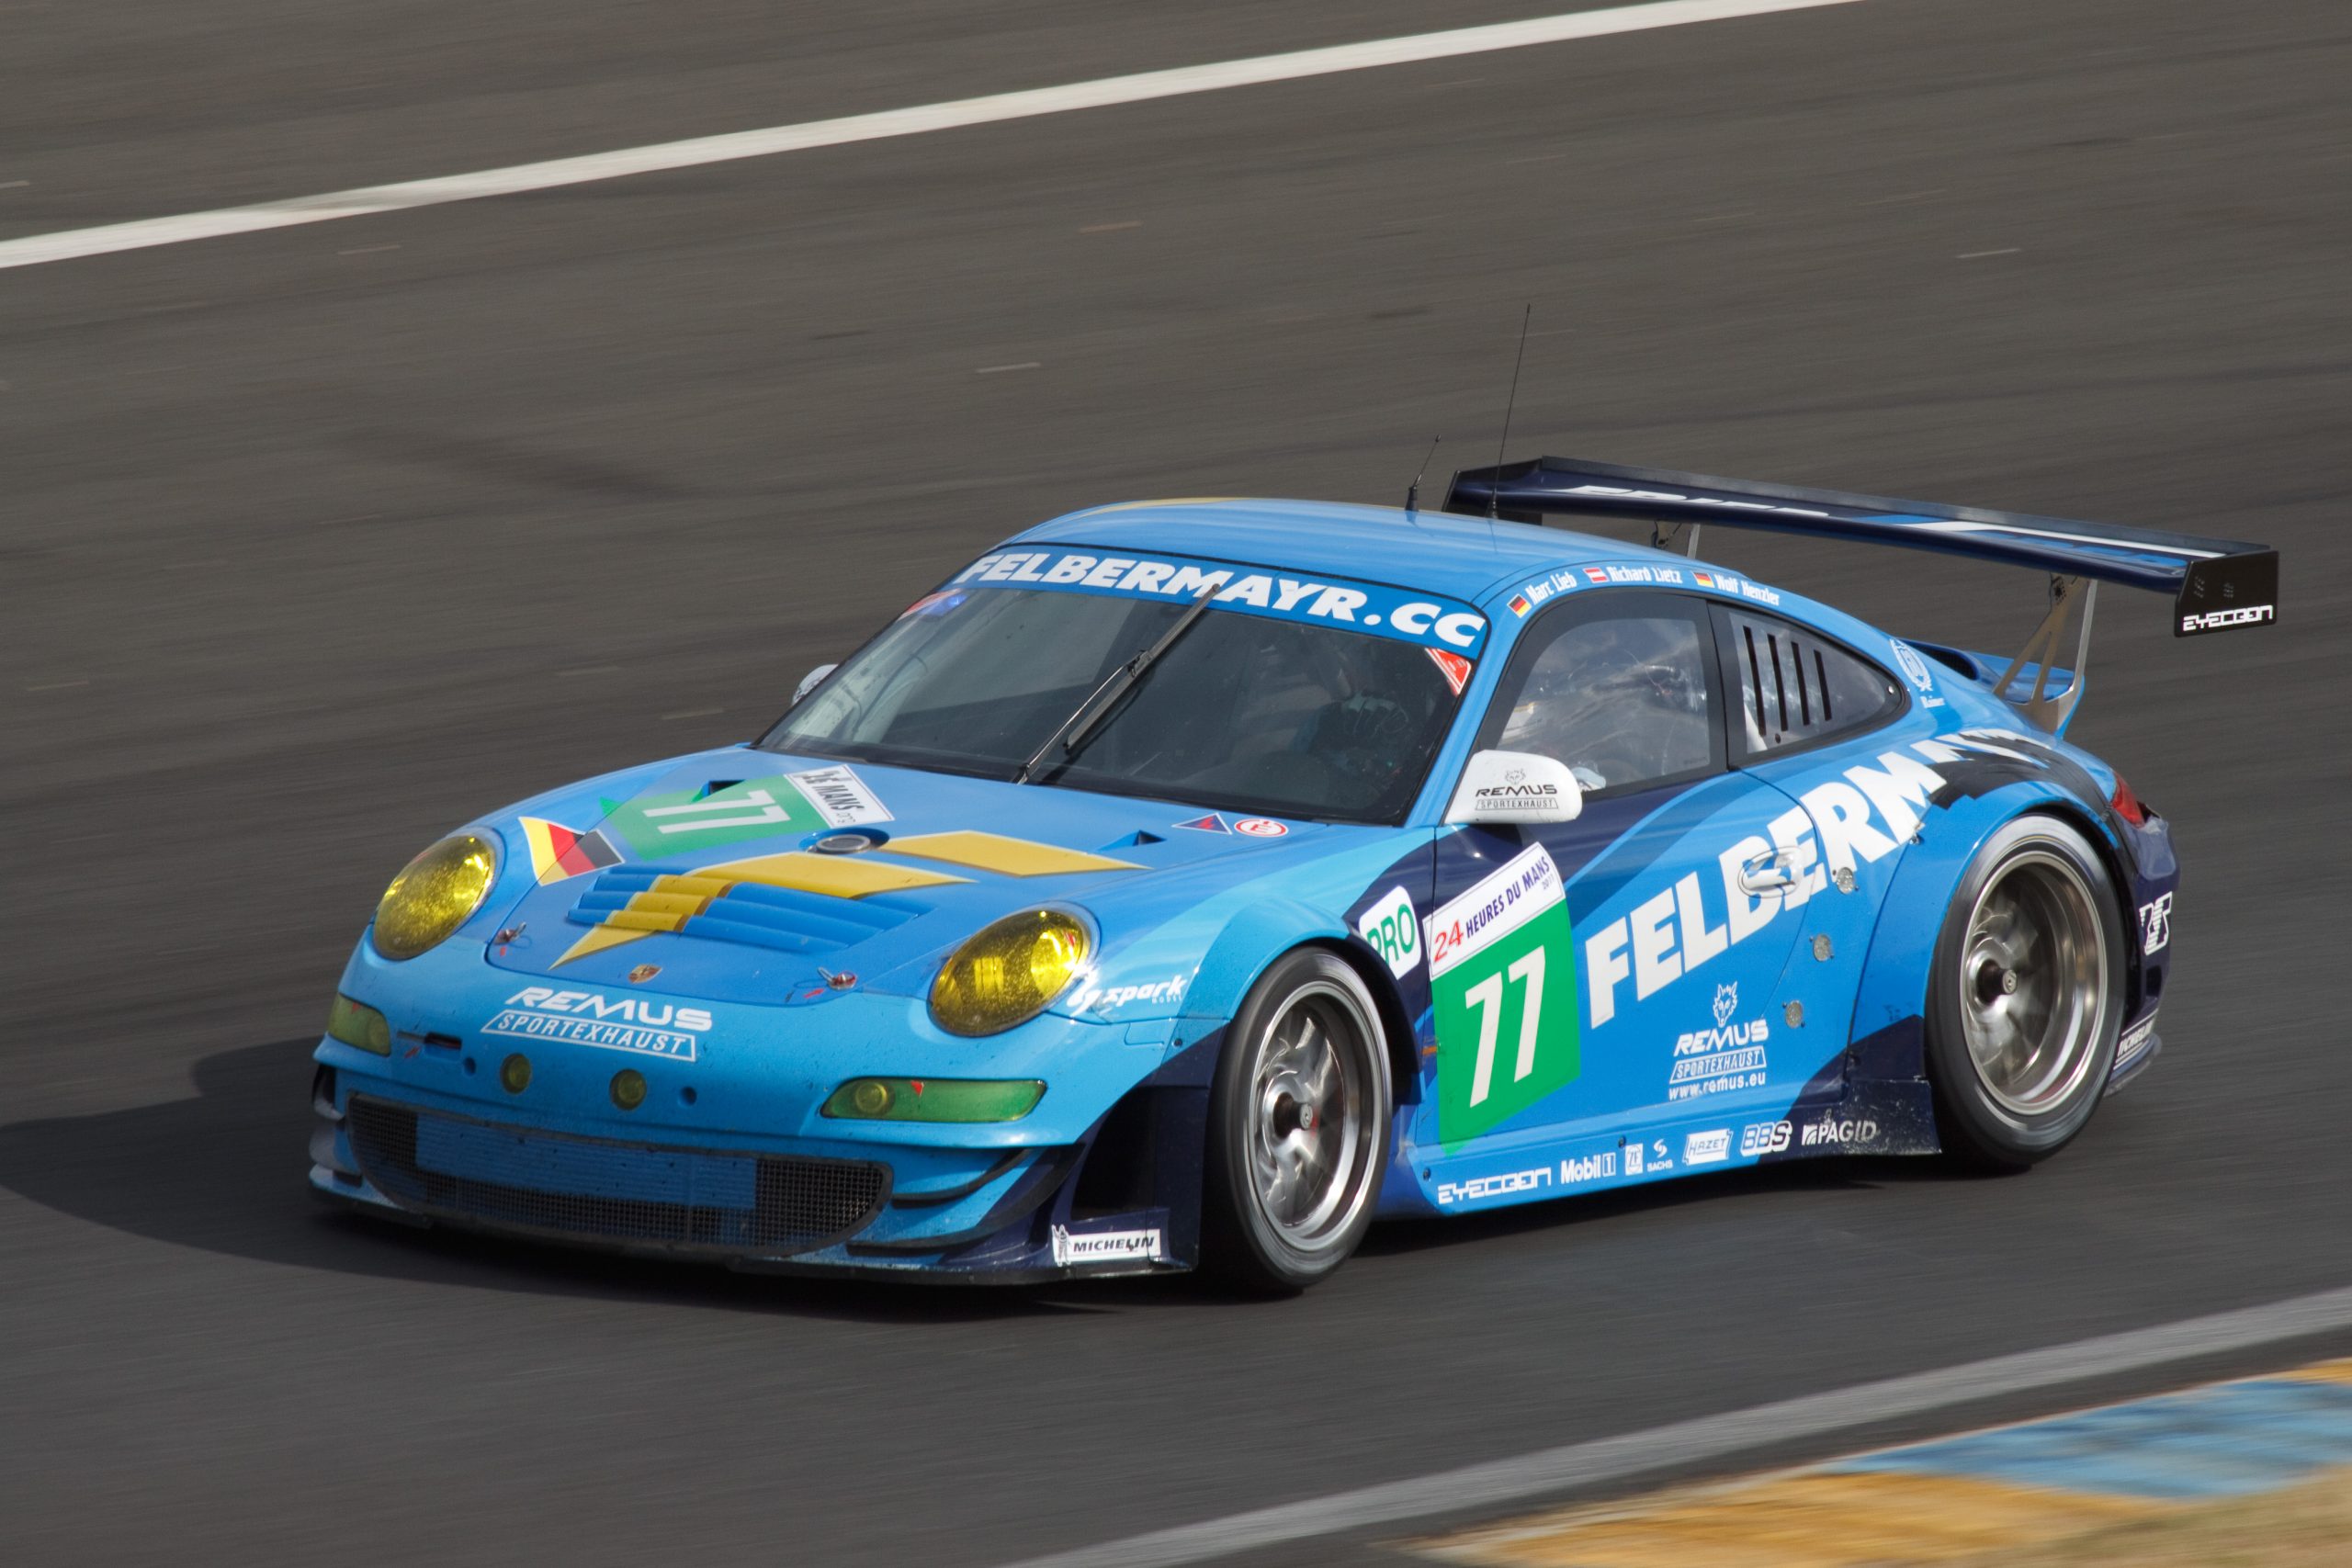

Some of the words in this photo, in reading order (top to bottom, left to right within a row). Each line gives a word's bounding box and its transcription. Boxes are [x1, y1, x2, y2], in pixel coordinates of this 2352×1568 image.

[1526, 583, 1551, 605] Marc
[1551, 571, 1577, 593] Lieb
[1607, 566, 1653, 582] Richard
[1714, 573, 1739, 592] Wolf
[1742, 582, 1781, 605] Henzler
[952, 553, 1487, 647] FELBERMAYR.CC
[1476, 784, 1557, 797] REMUS
[1481, 799, 1553, 809] SPORTEXHAUST
[642, 789, 791, 834] 77
[1434, 919, 1464, 963] 24
[1465, 895, 1505, 939] HEURES
[1507, 882, 1521, 905] DU
[1522, 856, 1551, 892] MANS
[1366, 903, 1415, 965] PRO
[505, 987, 712, 1032] REMUS
[1464, 944, 1545, 1108] 77
[498, 1013, 686, 1054] SPORTEXHAUST
[1674, 1019, 1769, 1056] REMUS
[1677, 1051, 1759, 1078] SPORTEXHAUST
[1669, 1072, 1766, 1100] www.remus.eu
[1690, 1136, 1726, 1156] HAZET
[1741, 1121, 1792, 1156] BBS
[1818, 1120, 1877, 1145] PAGID
[1647, 1159, 1673, 1171] SACHS
[1073, 1236, 1155, 1253] MICHELIN
